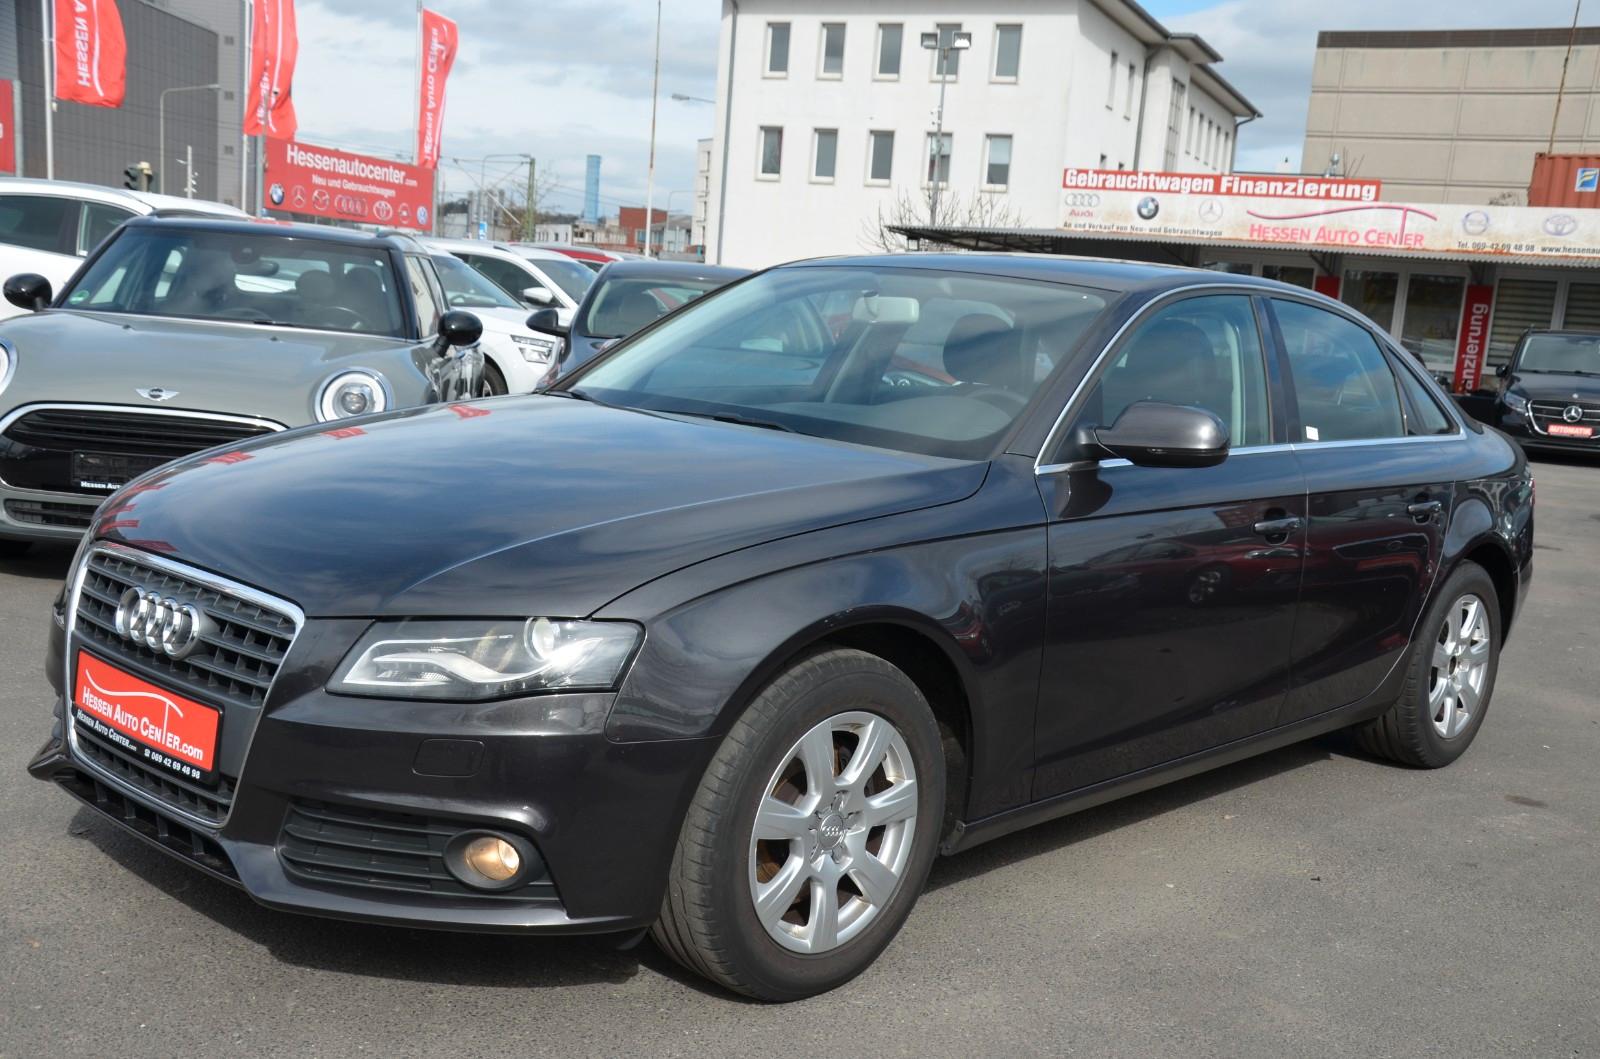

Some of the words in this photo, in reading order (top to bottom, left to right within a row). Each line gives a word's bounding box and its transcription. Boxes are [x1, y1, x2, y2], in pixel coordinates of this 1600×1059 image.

[311, 174, 327, 186] Neu
[327, 177, 341, 189] und
[342, 178, 396, 199] Gebrauchtwagen
[1065, 168, 1214, 194] Gebrauchtwagen
[1220, 175, 1377, 202] Finanzierung
[1069, 208, 1094, 218] Audi
[1063, 221, 1072, 229] An
[1088, 222, 1115, 231] Verkauf
[1163, 226, 1223, 238] Gebrauchtwagen
[1249, 224, 1311, 242] HESSEN
[1315, 225, 1360, 243] AUTO
[1364, 214, 1424, 246] CENTER
[1457, 241, 1470, 249] Tel.
[1513, 244, 1523, 252] 48
[1525, 244, 1535, 252] 98
[80, 481, 107, 489] HESSEN
[107, 482, 121, 490] AUT
[82, 686, 113, 719] HESSEN
[113, 704, 139, 732] AUTO
[140, 706, 204, 762] CENTER.com
[76, 709, 95, 728] HESSEN
[94, 720, 109, 736] AUTO
[151, 752, 163, 765] 069
[163, 757, 172, 768] 42
[172, 760, 182, 772] 69
[181, 765, 191, 776] 48
[191, 769, 201, 780] 98
